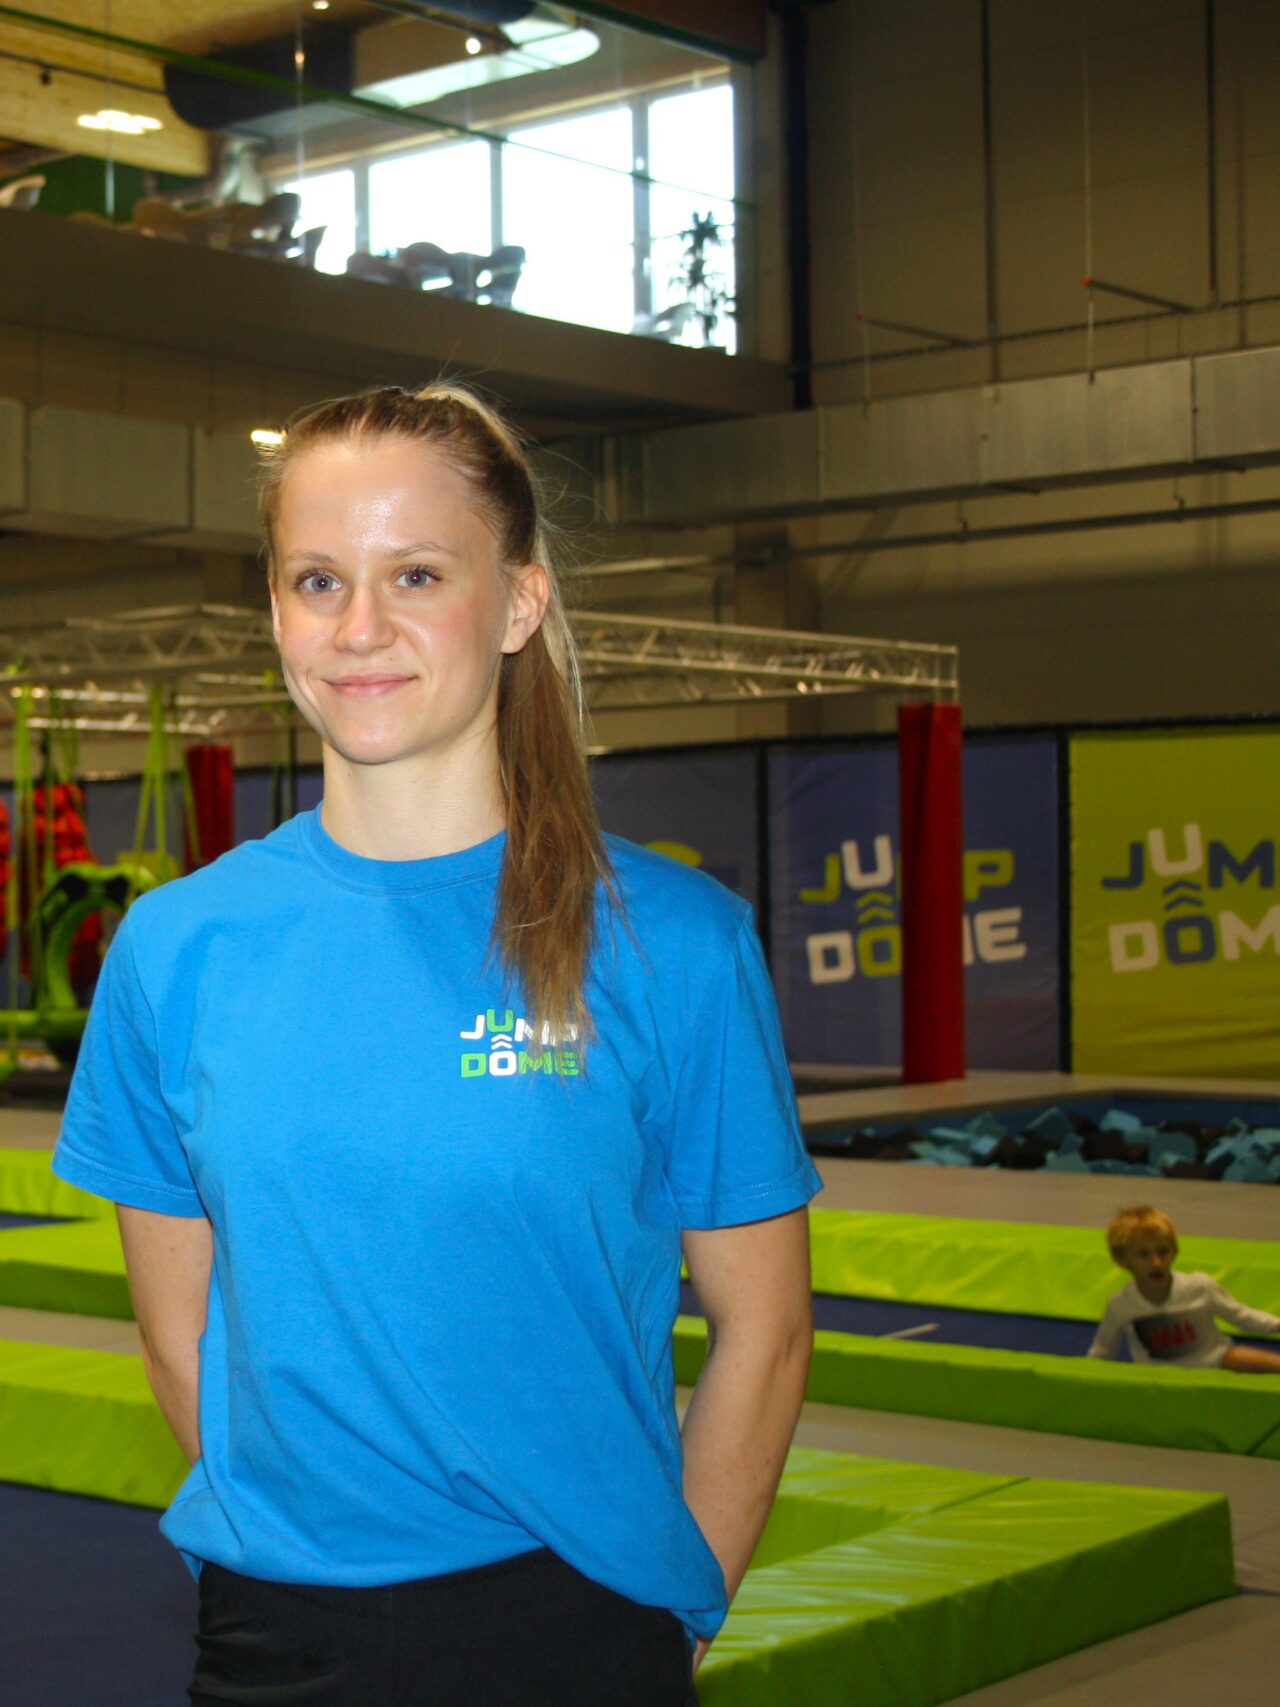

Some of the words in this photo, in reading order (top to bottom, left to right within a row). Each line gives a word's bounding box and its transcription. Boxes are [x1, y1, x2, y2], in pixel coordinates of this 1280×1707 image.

[799, 833, 1015, 903] JUP
[1100, 822, 1275, 890] JUM
[806, 906, 1027, 986] DOE
[1108, 903, 1280, 973] DOM
